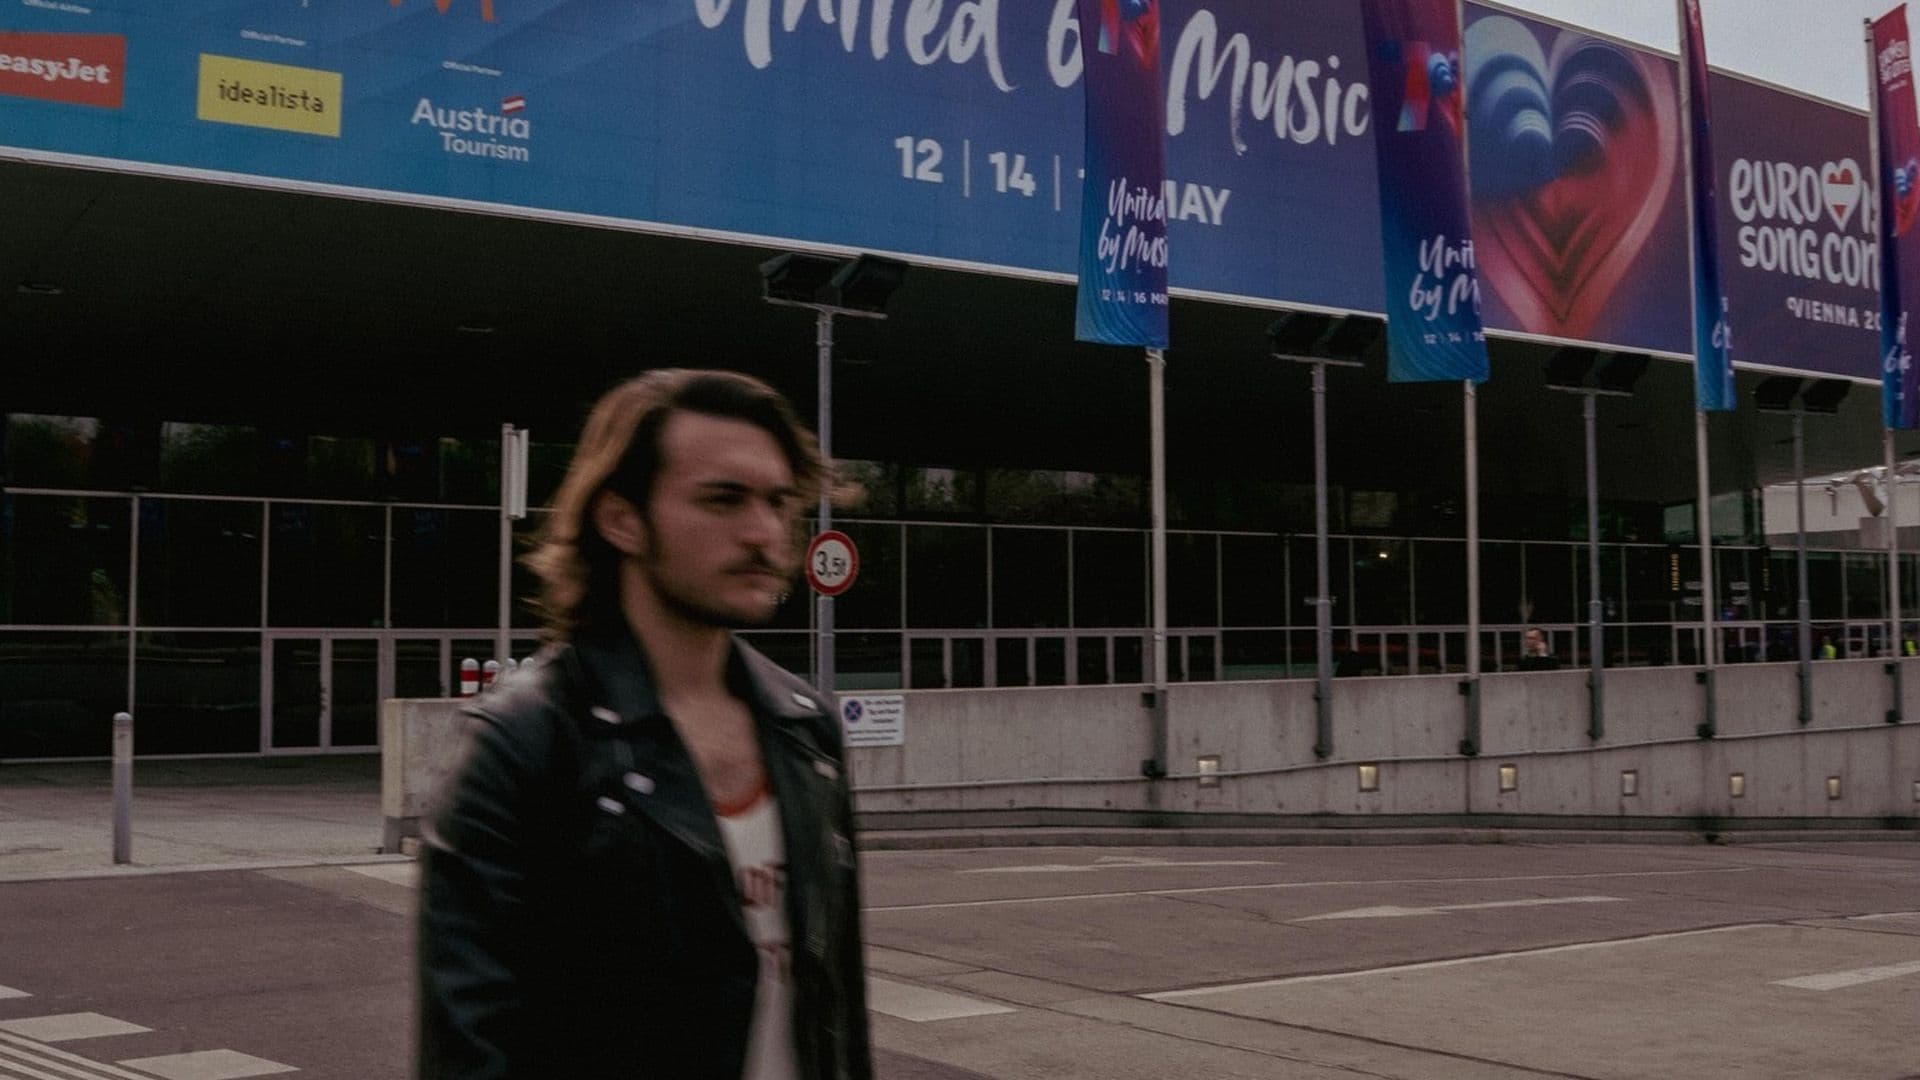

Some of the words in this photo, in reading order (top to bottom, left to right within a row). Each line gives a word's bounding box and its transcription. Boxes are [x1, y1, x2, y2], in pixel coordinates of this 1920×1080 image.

[0, 53, 111, 84] easyJet
[1167, 9, 1370, 155] Music
[217, 78, 325, 114] idealista
[410, 97, 530, 139] Austria
[440, 131, 529, 162] Tourism
[895, 136, 944, 183] 12
[989, 151, 1036, 196] 14
[1108, 177, 1168, 227] United
[1098, 217, 1121, 274] by
[1409, 273, 1443, 322] by
[1786, 297, 1860, 329] VIENNA
